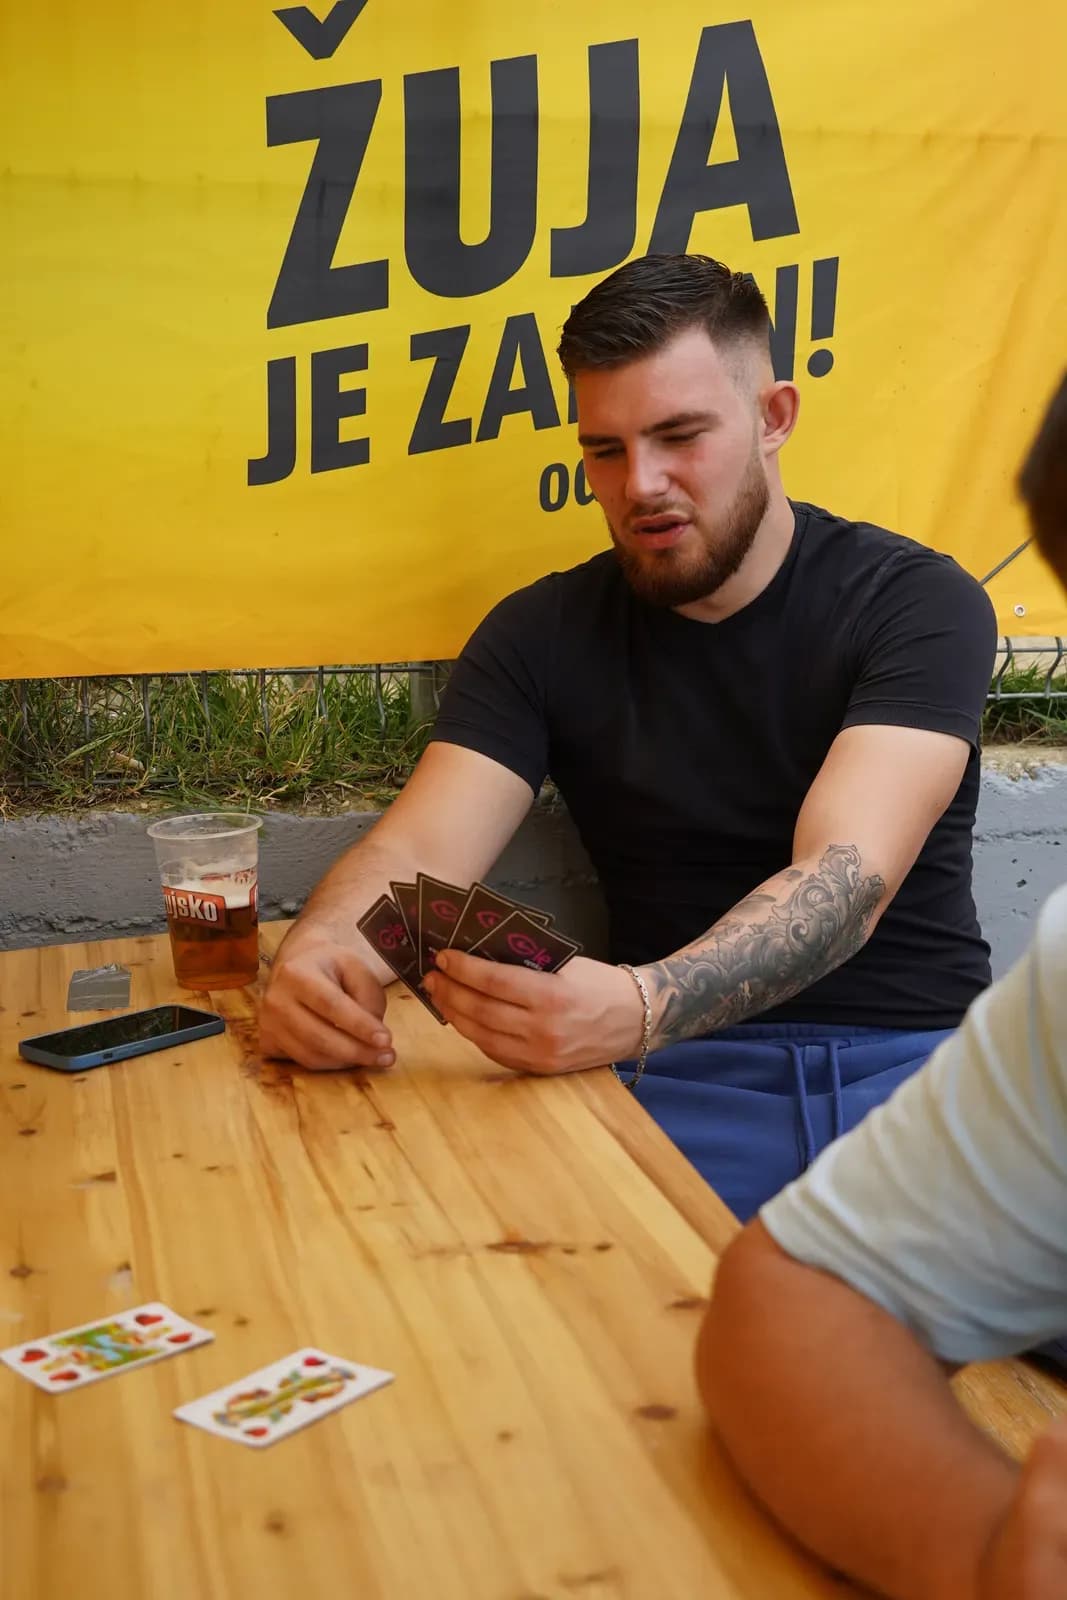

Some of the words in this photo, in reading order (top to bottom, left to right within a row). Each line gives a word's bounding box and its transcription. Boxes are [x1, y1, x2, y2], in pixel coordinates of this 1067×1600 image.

[266, 0, 800, 329] ŽUJA
[248, 343, 370, 485] JE
[408, 257, 839, 455] ZAN!
